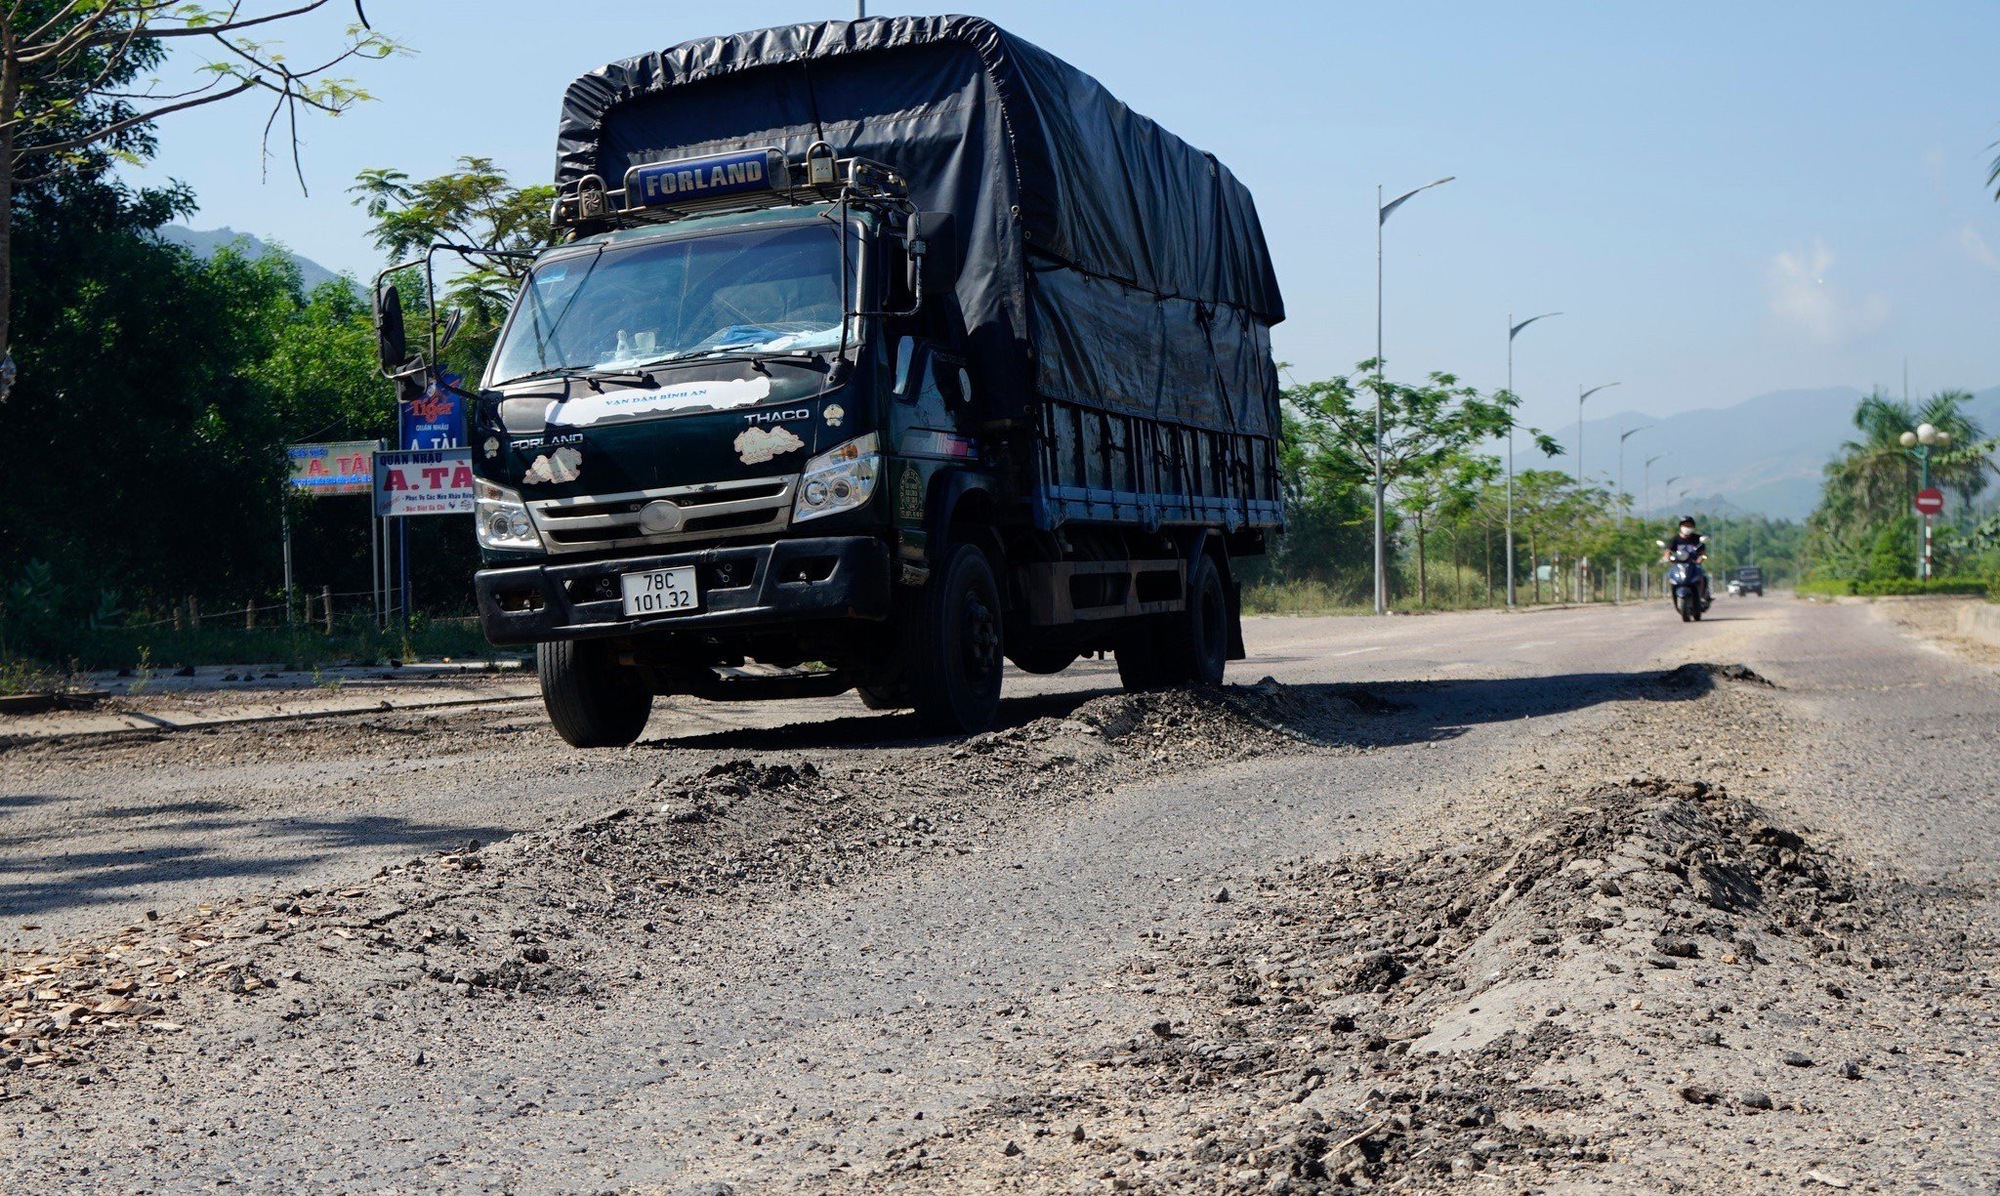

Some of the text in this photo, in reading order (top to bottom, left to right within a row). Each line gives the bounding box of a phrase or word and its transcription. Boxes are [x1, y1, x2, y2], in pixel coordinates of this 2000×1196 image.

[646, 161, 762, 196] FORLAND
[690, 389, 707, 397] AN
[410, 397, 454, 423] Tiger
[744, 409, 809, 424] THACO
[431, 433, 457, 449] TÀI
[510, 433, 583, 451] FORLAND
[643, 573, 675, 591] 78C
[635, 590, 690, 611] 101.32
